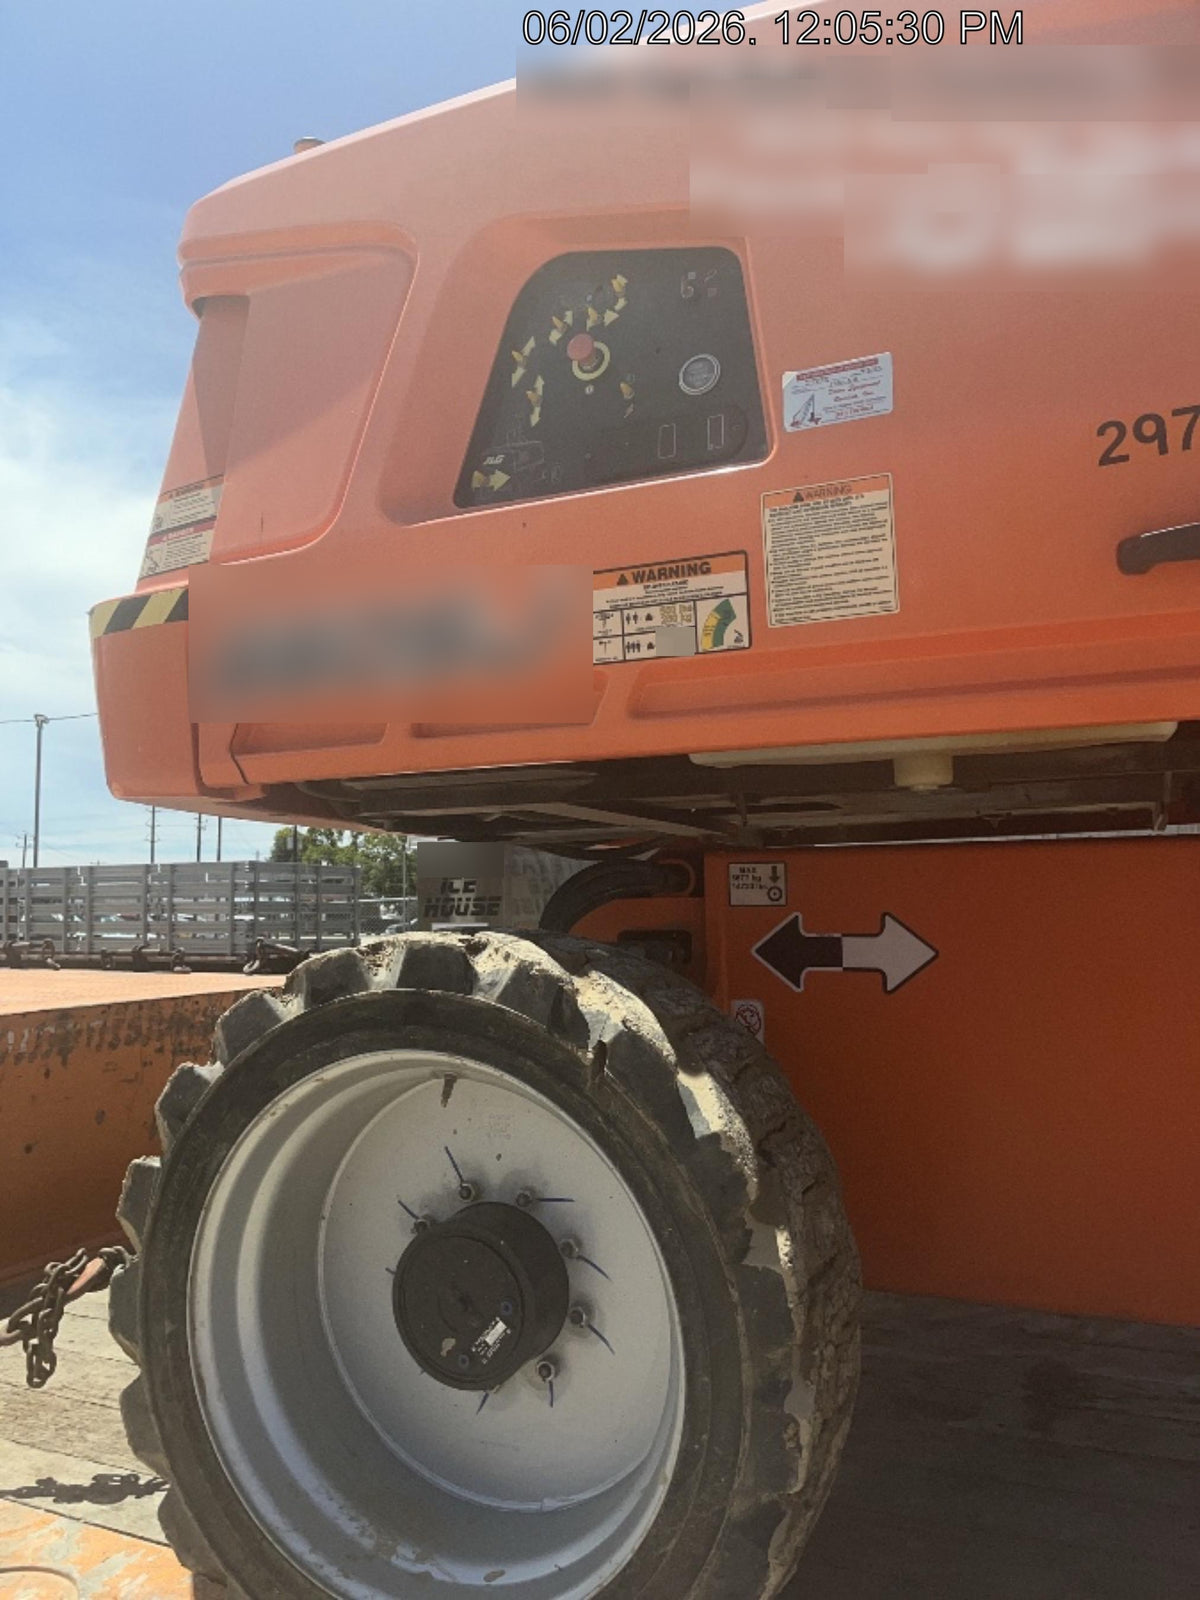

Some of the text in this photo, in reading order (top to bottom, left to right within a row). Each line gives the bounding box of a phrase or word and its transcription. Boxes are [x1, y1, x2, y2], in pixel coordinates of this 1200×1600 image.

[632, 561, 712, 583] WARNING
[440, 877, 477, 894] ICE
[424, 895, 503, 917] HOUSE
